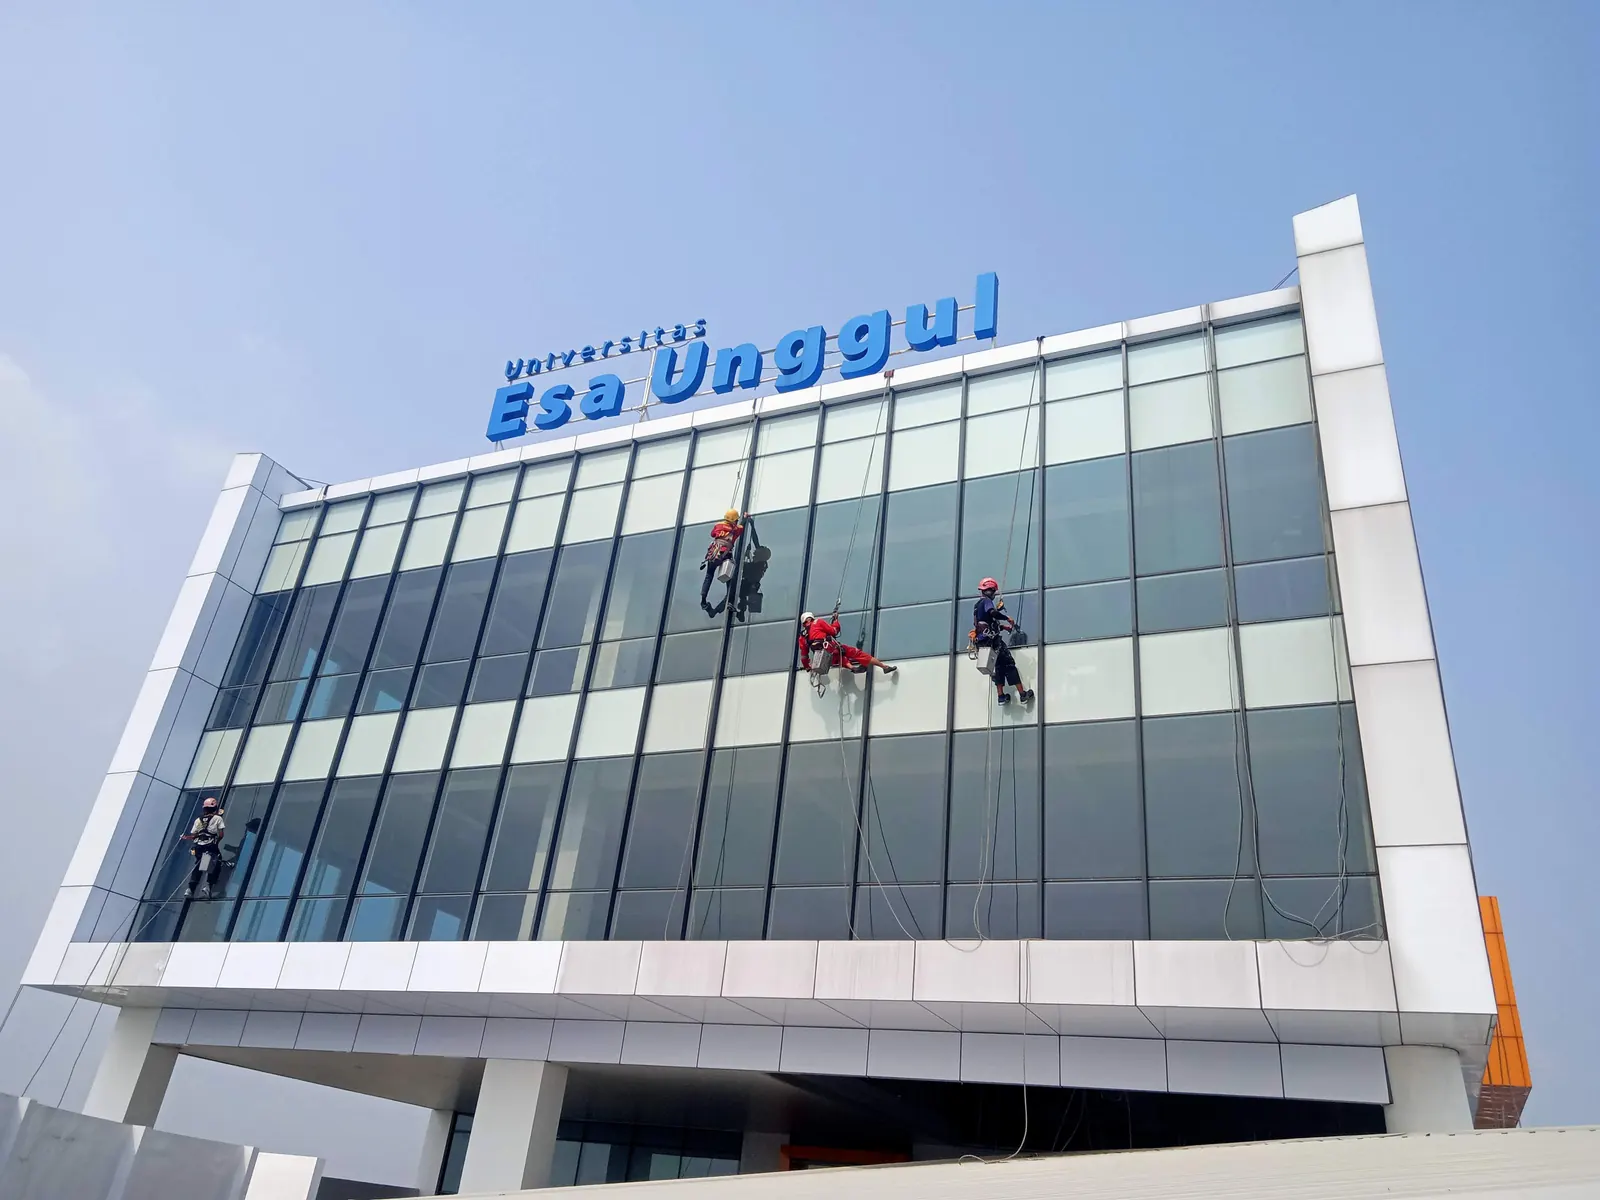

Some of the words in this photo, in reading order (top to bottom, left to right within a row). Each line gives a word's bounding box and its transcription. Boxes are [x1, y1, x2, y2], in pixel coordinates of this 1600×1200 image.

[486, 373, 625, 442] Esa
[651, 272, 999, 404] Unggul
[504, 318, 707, 380] Universitas
